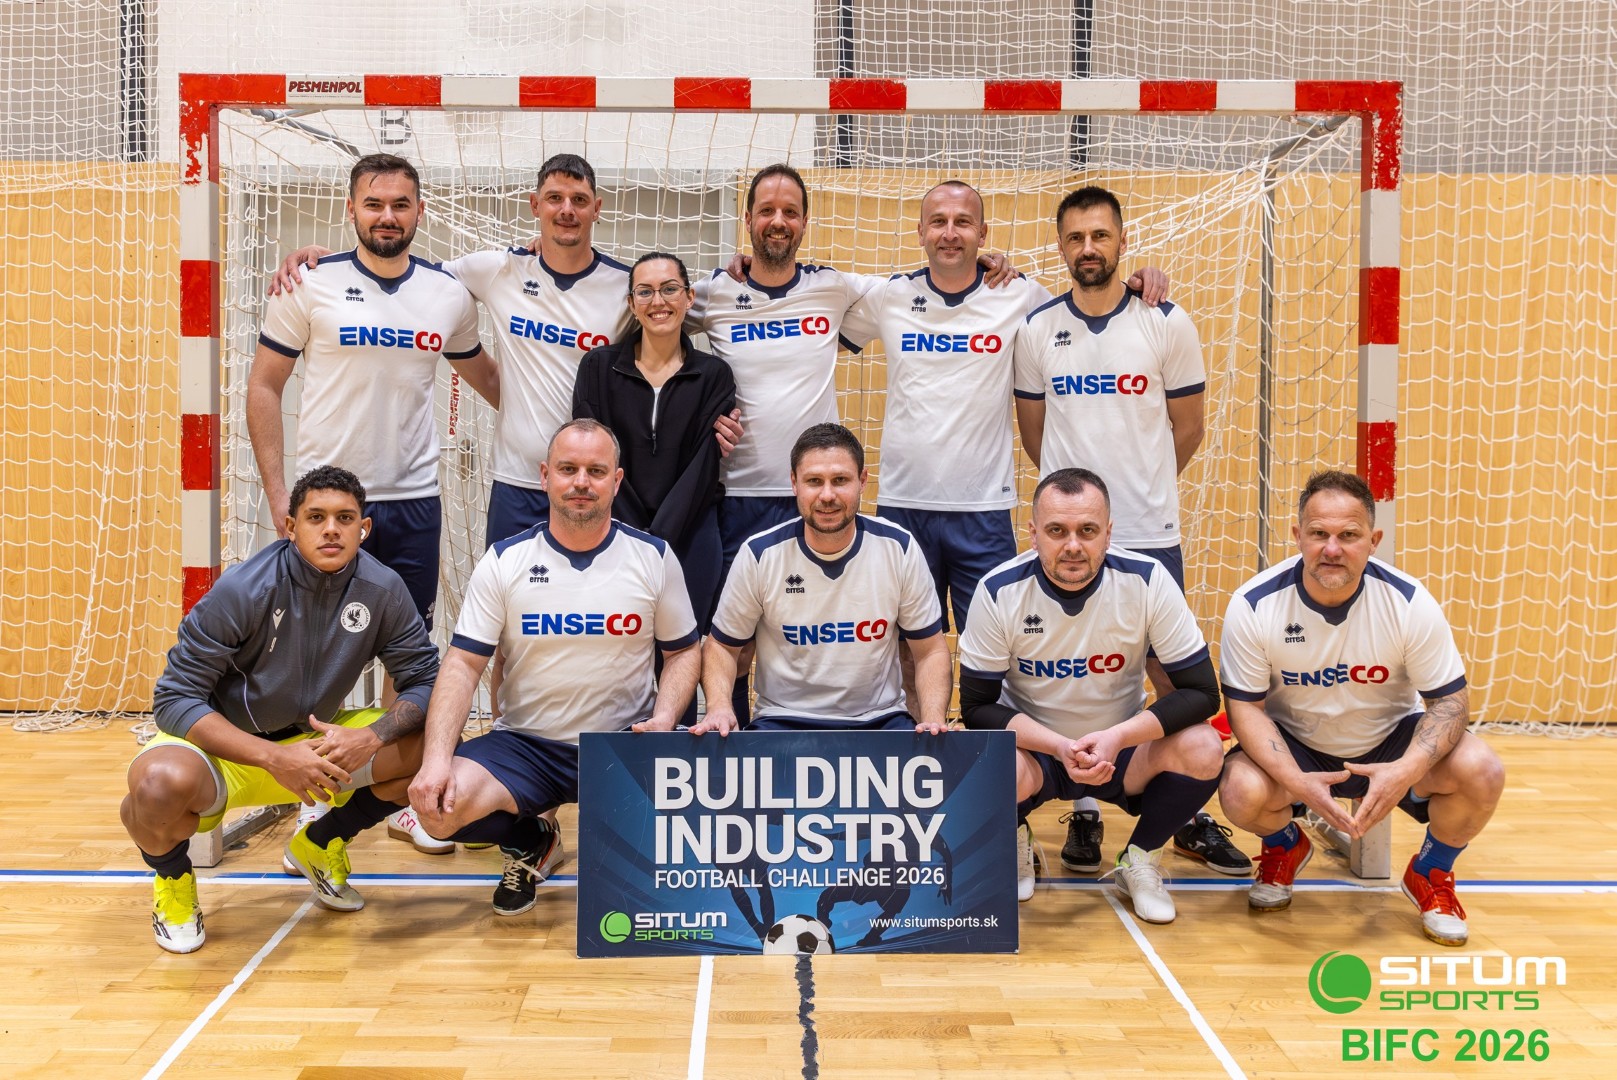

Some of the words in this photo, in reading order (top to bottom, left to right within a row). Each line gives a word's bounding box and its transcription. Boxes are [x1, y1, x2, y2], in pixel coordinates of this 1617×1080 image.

[288, 81, 362, 93] PESMENPOL
[345, 295, 364, 303] errea
[339, 326, 443, 352] ENSECO
[731, 316, 830, 343] ENSECO
[901, 333, 1003, 354] ENSECO
[1051, 373, 1149, 396] ENSECO
[785, 586, 806, 594] errea
[521, 613, 643, 636] ENSECO
[782, 618, 888, 645] ENSECO
[1284, 635, 1306, 643] errea
[1017, 653, 1126, 679] ENSECO
[1281, 663, 1390, 688] ENSECO
[654, 755, 944, 810] BUILDING
[655, 813, 947, 865] INDUSTRY
[655, 868, 763, 889] FOOTBALL
[768, 868, 891, 888] CHALLENGE
[896, 866, 945, 885] 2026
[635, 912, 727, 929] SITUM
[869, 914, 999, 930] www.situmsports.sk
[635, 929, 714, 941] SPORTS
